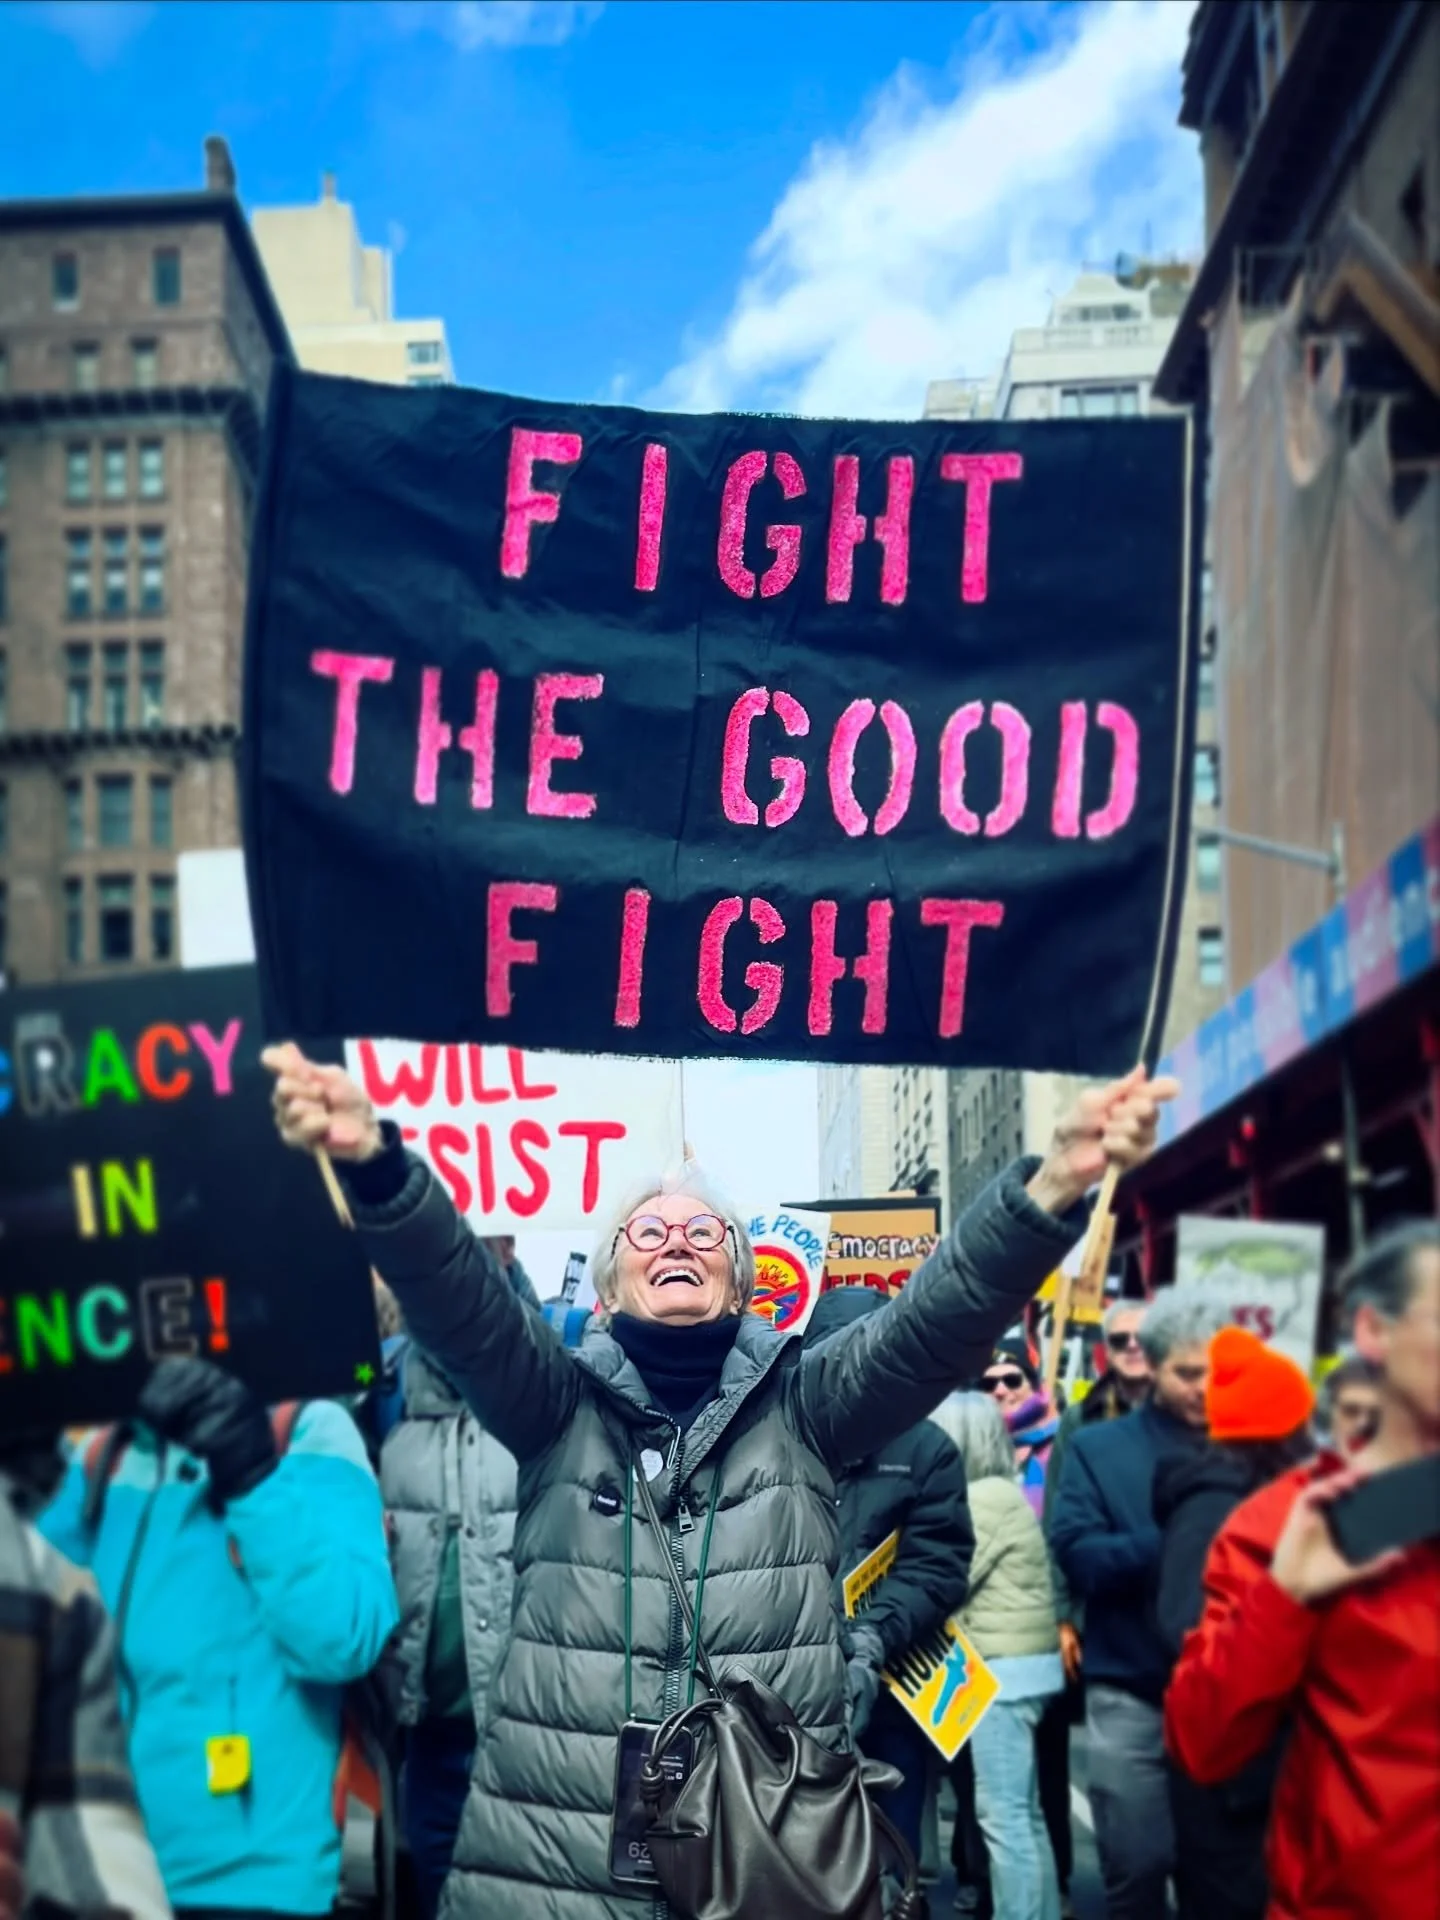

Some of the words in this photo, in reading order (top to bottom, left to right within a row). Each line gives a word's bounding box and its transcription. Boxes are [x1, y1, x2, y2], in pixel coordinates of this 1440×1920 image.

[501, 427, 1022, 605] FIGHT
[310, 649, 604, 818] THE
[721, 686, 1139, 839] GOOD
[486, 882, 1004, 1038] FIGHT
[0, 1014, 242, 1116] RACY
[358, 1038, 557, 1107] WILL
[71, 1158, 157, 1239] IN
[402, 1119, 627, 1217] SIST
[771, 1214, 823, 1271] PEOPLE
[0, 1276, 230, 1371] NCE!
